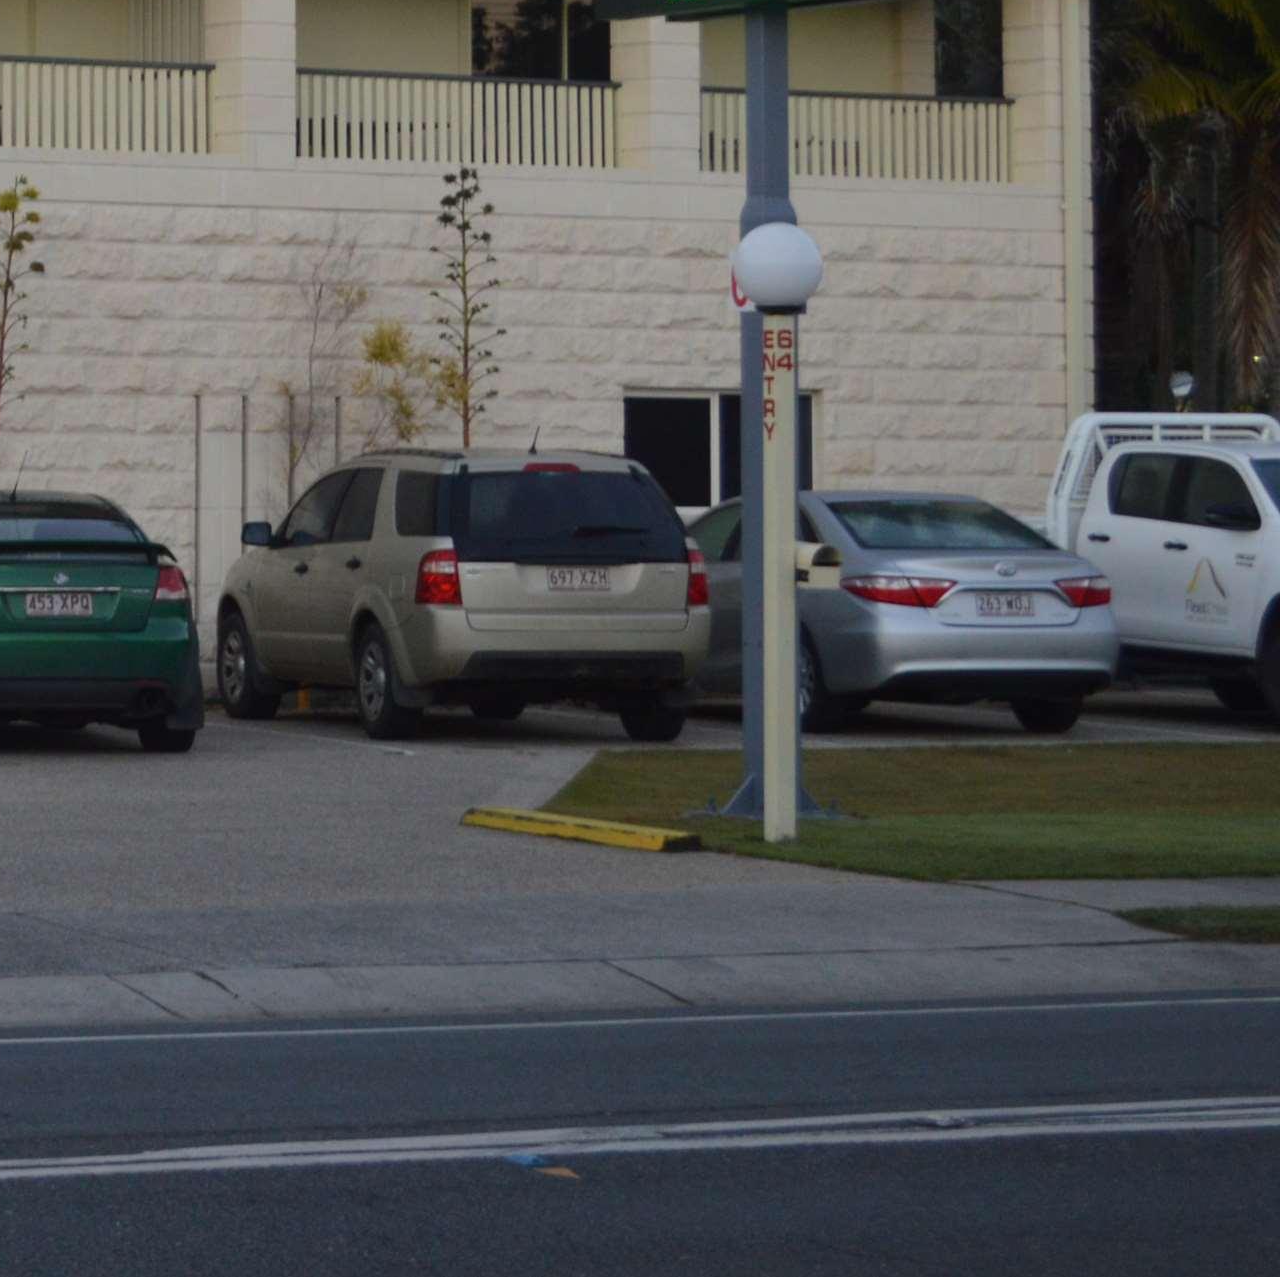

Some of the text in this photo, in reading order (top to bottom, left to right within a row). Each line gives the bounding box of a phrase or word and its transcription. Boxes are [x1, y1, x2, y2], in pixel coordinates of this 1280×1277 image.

[763, 329, 776, 441] ENTRY
[549, 570, 573, 585] 697
[28, 593, 54, 610] 453
